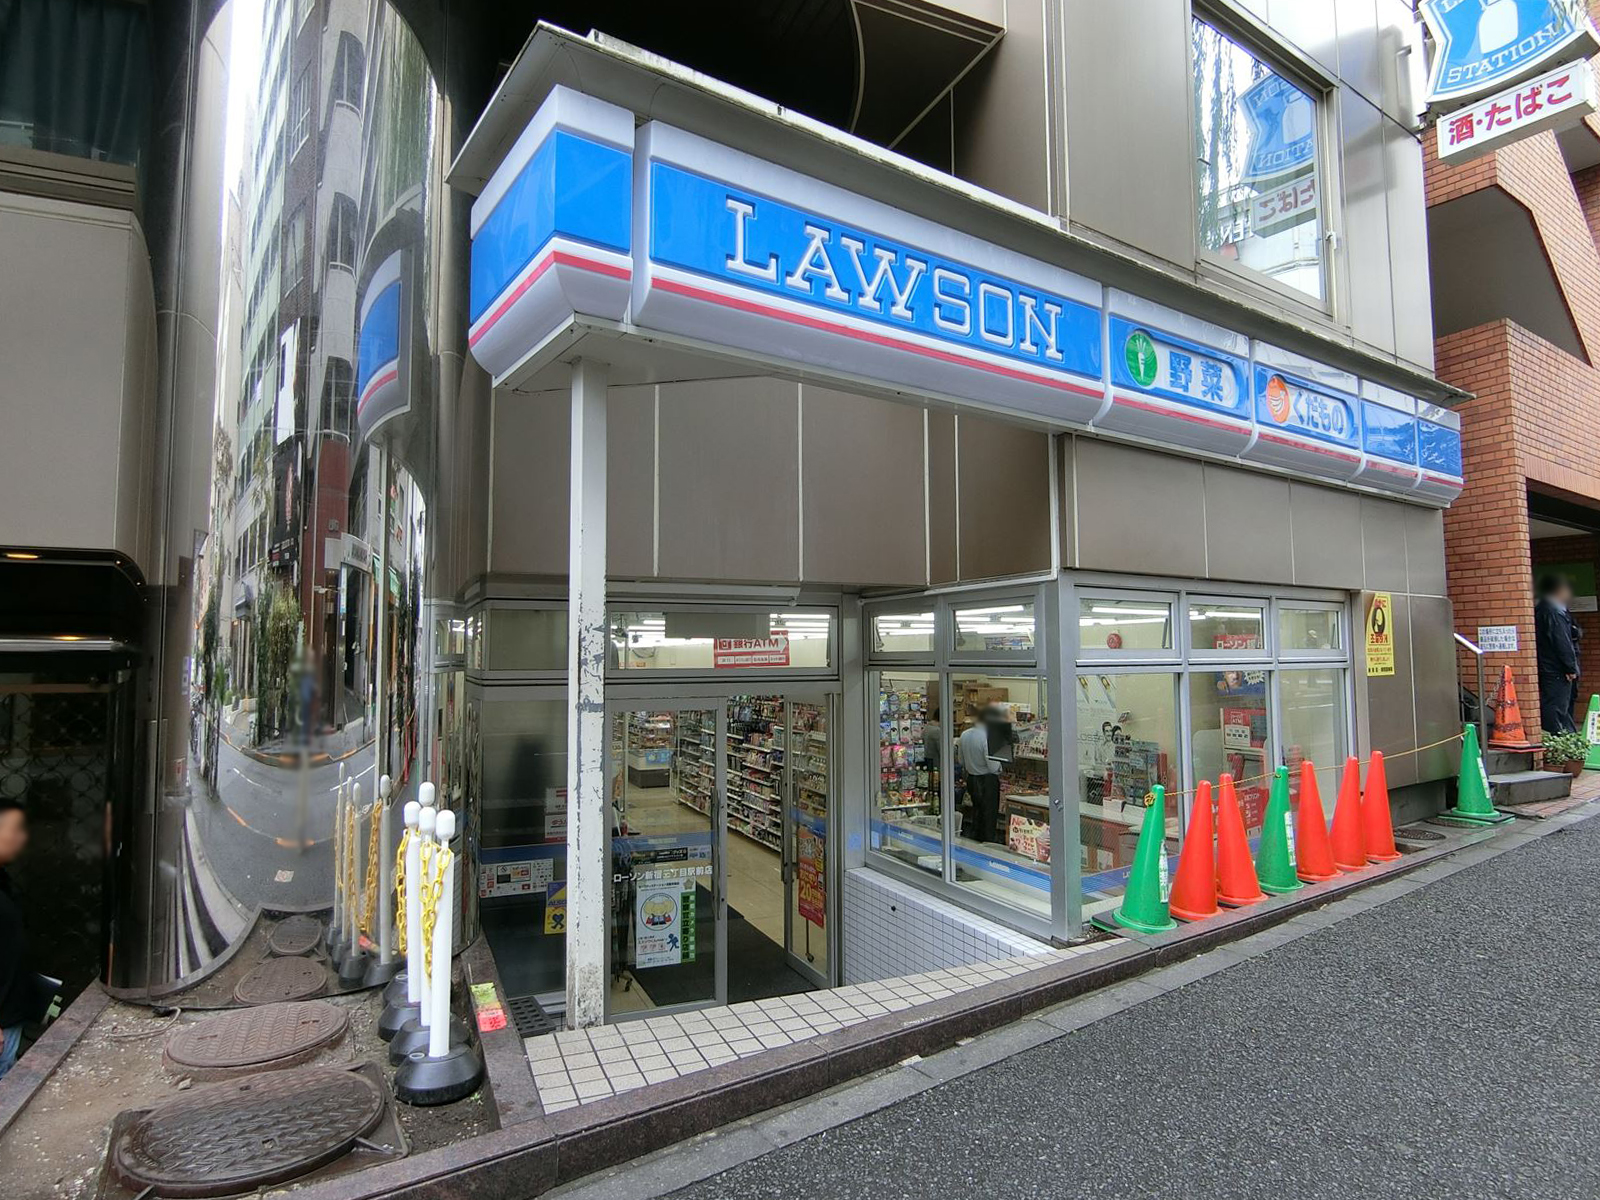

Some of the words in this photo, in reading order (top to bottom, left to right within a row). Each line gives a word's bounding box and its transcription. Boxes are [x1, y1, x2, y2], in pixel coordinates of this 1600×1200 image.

[1446, 22, 1559, 84] STATION
[1448, 75, 1573, 146] 酒・たばこ
[725, 196, 1065, 362] LAWSON
[1168, 350, 1224, 402] 野菜
[1293, 391, 1346, 435] くだもの
